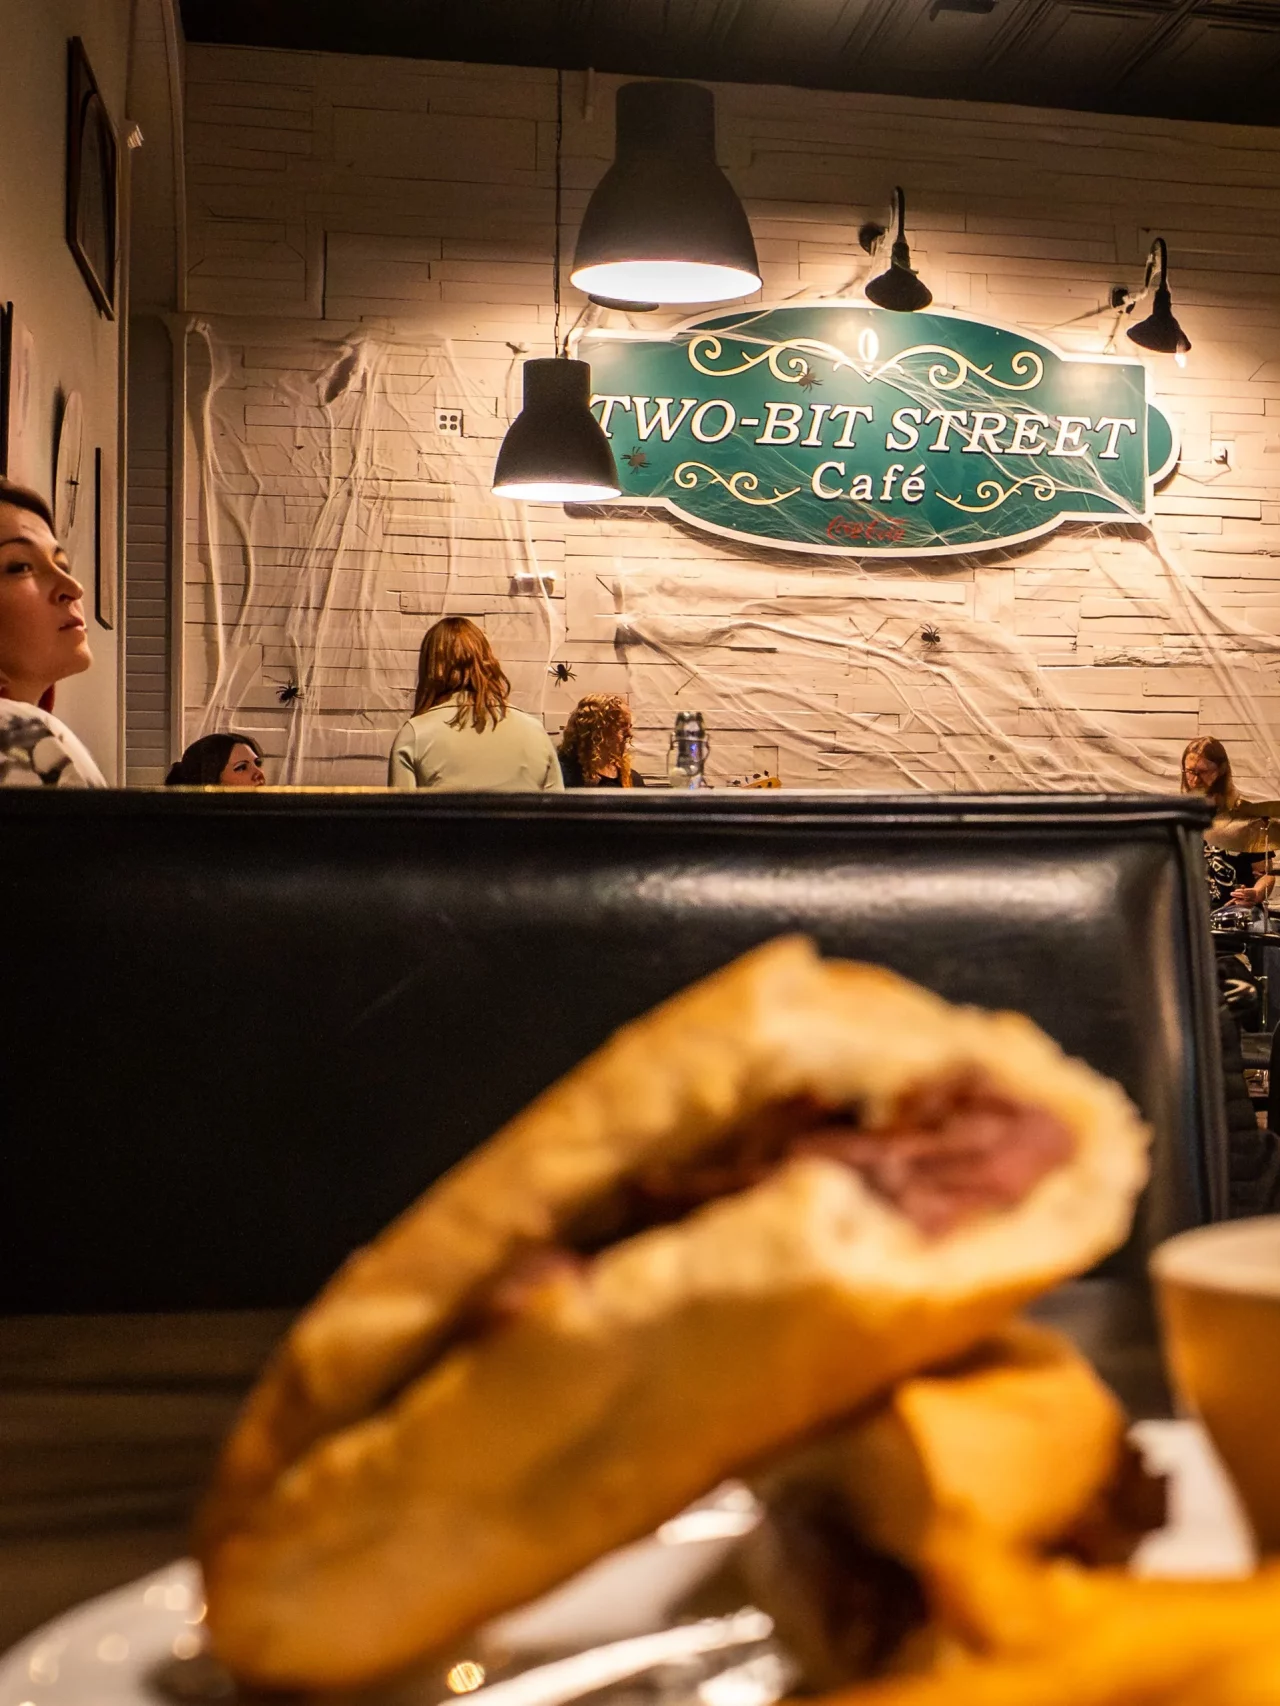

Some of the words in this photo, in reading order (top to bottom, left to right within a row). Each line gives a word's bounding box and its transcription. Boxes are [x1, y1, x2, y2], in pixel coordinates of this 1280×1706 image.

[589, 394, 873, 448] TWO-BIT
[886, 407, 1136, 459] STREET
[811, 461, 926, 503] Café
